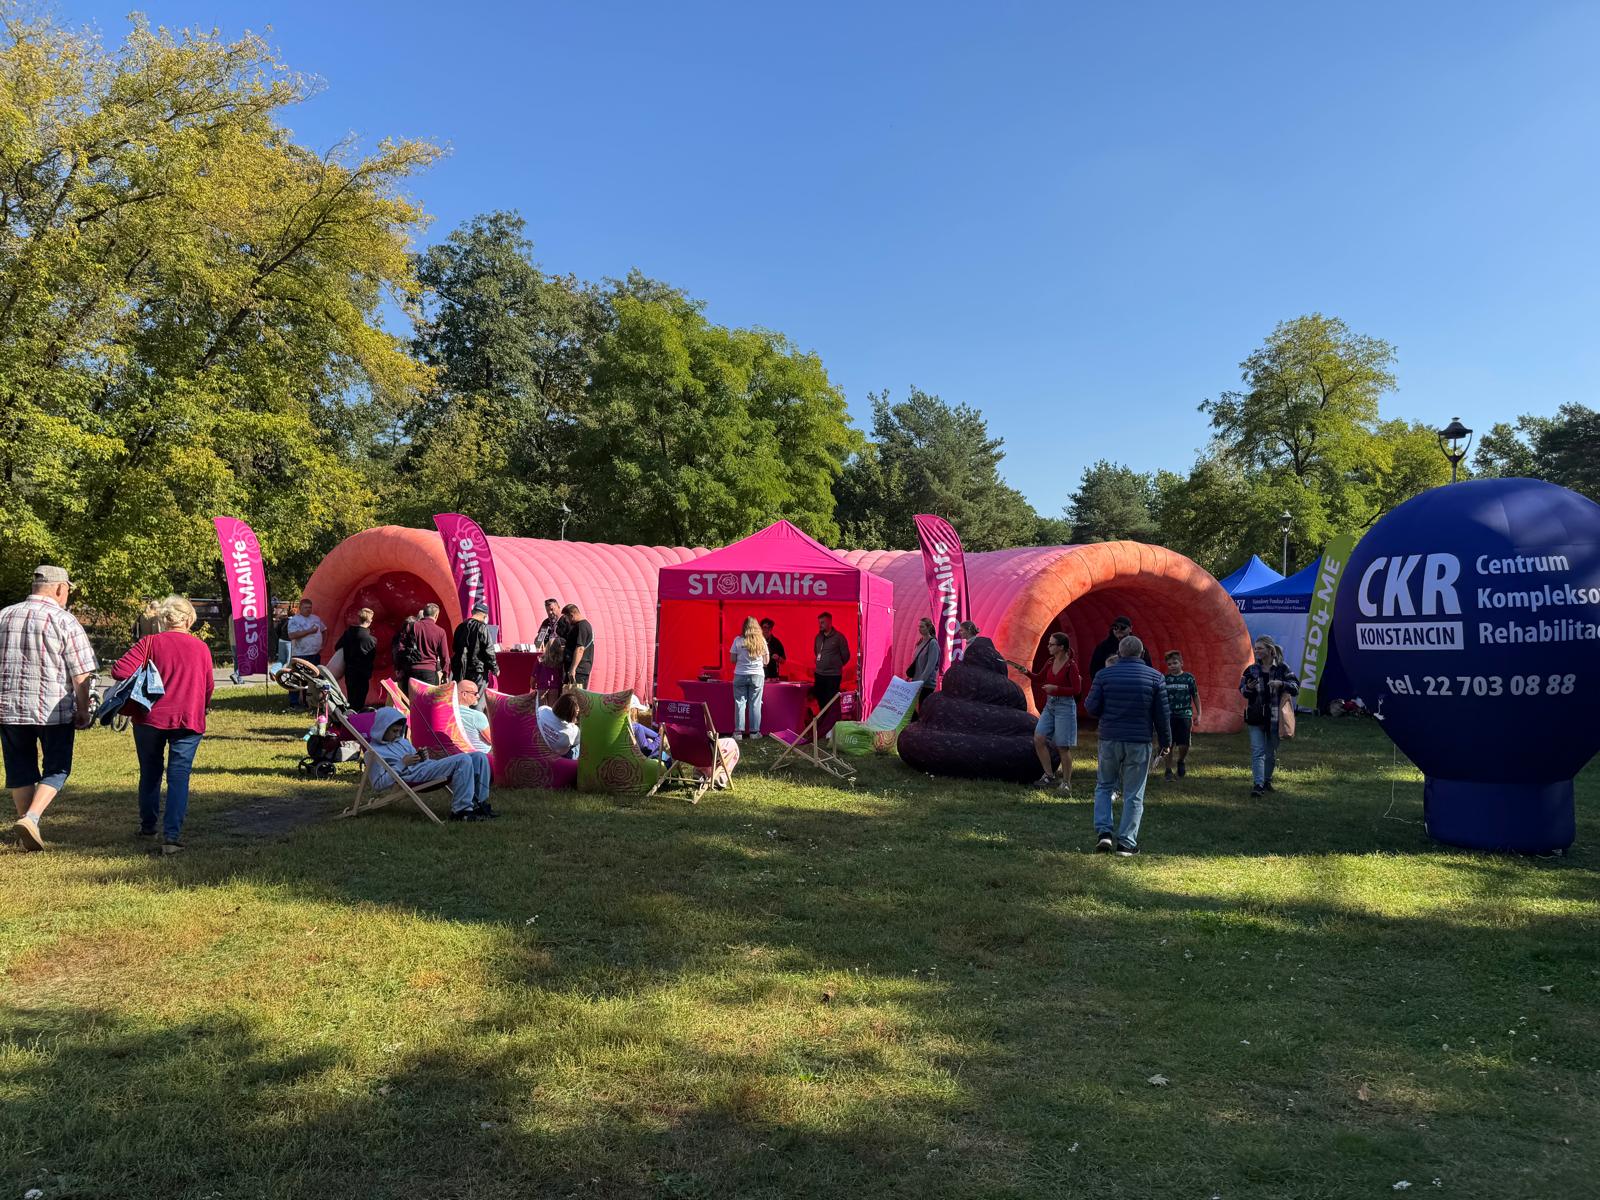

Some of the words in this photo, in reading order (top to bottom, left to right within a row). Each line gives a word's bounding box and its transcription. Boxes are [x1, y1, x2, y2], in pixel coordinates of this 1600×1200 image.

[1476, 554, 1570, 575] Centrum
[231, 539, 259, 644] STOMAlife
[1357, 552, 1462, 617] CKR
[1477, 583, 1600, 612] Komplekso
[932, 541, 965, 661] STOMAlife
[1360, 626, 1455, 646] KONSTANCIN
[1385, 674, 1422, 695] tel.
[1423, 675, 1453, 696] 22
[1456, 675, 1503, 697] 703
[1510, 674, 1541, 697] 08
[1545, 673, 1577, 696] 88
